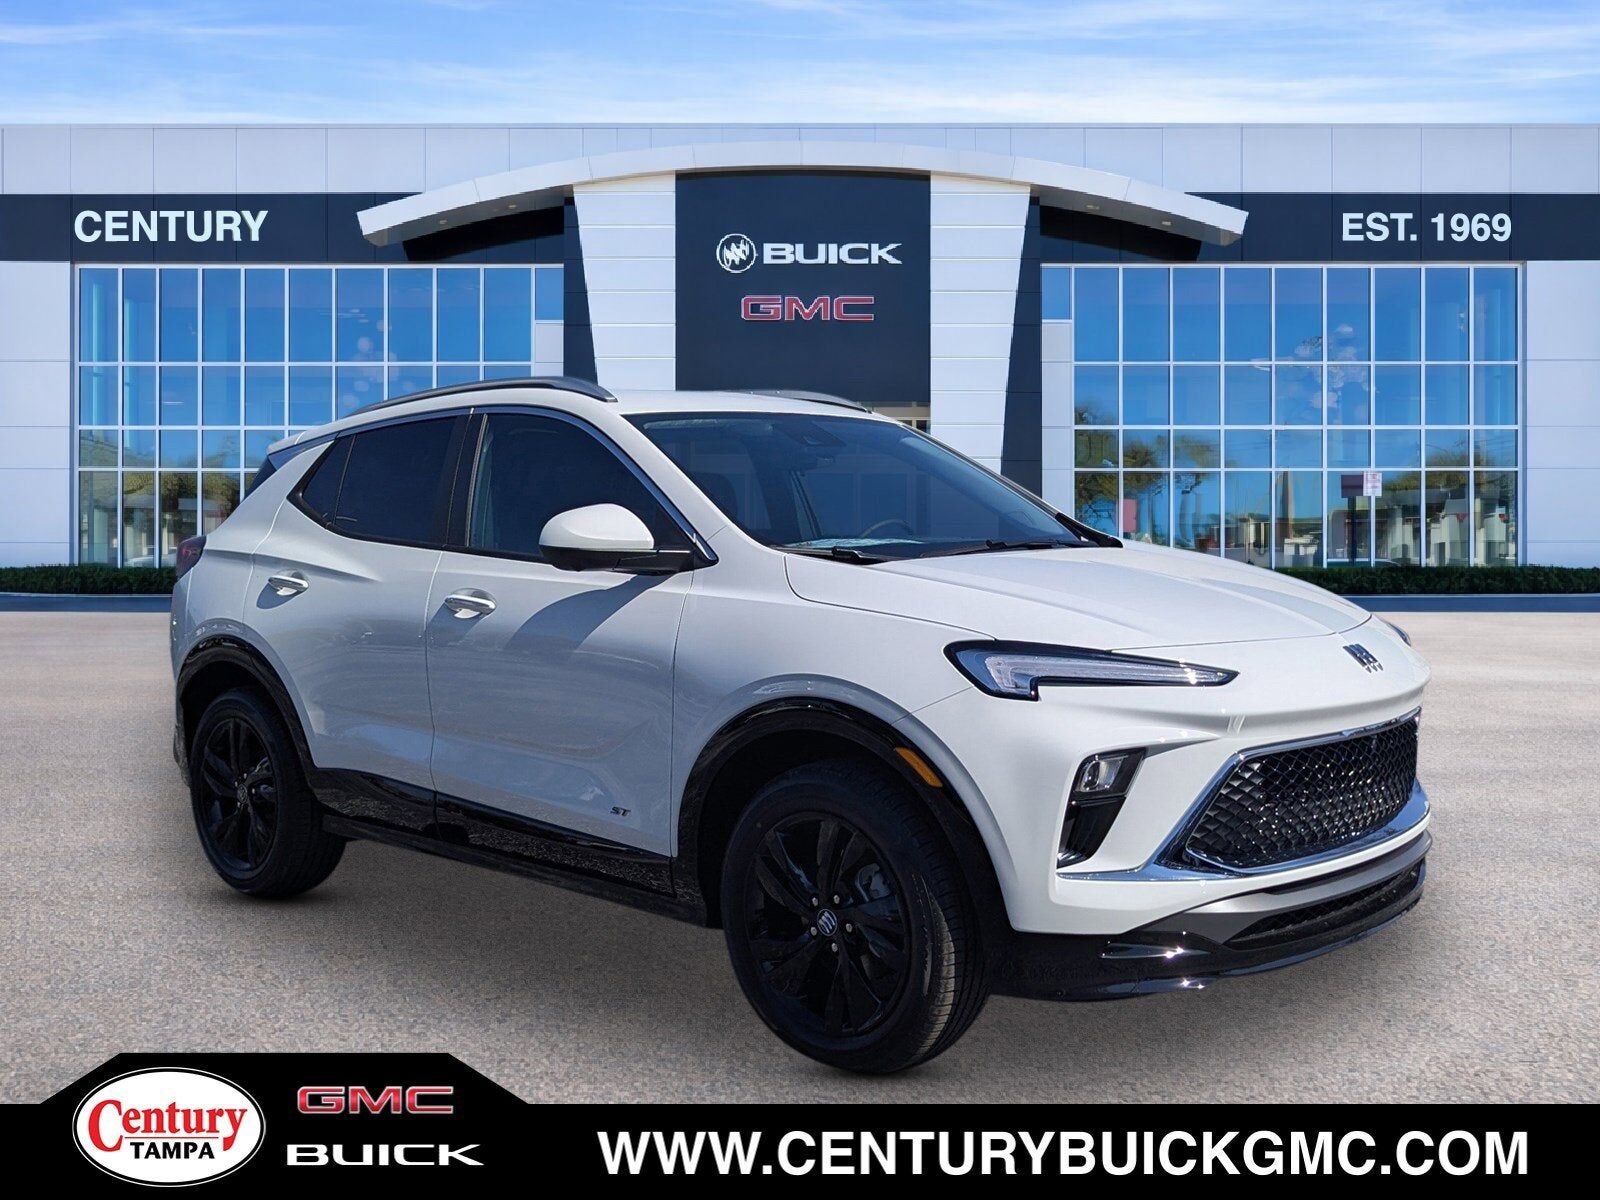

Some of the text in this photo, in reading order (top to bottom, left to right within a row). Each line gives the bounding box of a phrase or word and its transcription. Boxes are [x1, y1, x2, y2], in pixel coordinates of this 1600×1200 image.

[74, 210, 269, 243] CENTURY
[1342, 212, 1512, 242] EST. 1969
[763, 243, 902, 265] BUICK
[741, 295, 875, 321] GMC
[610, 806, 632, 817] ST
